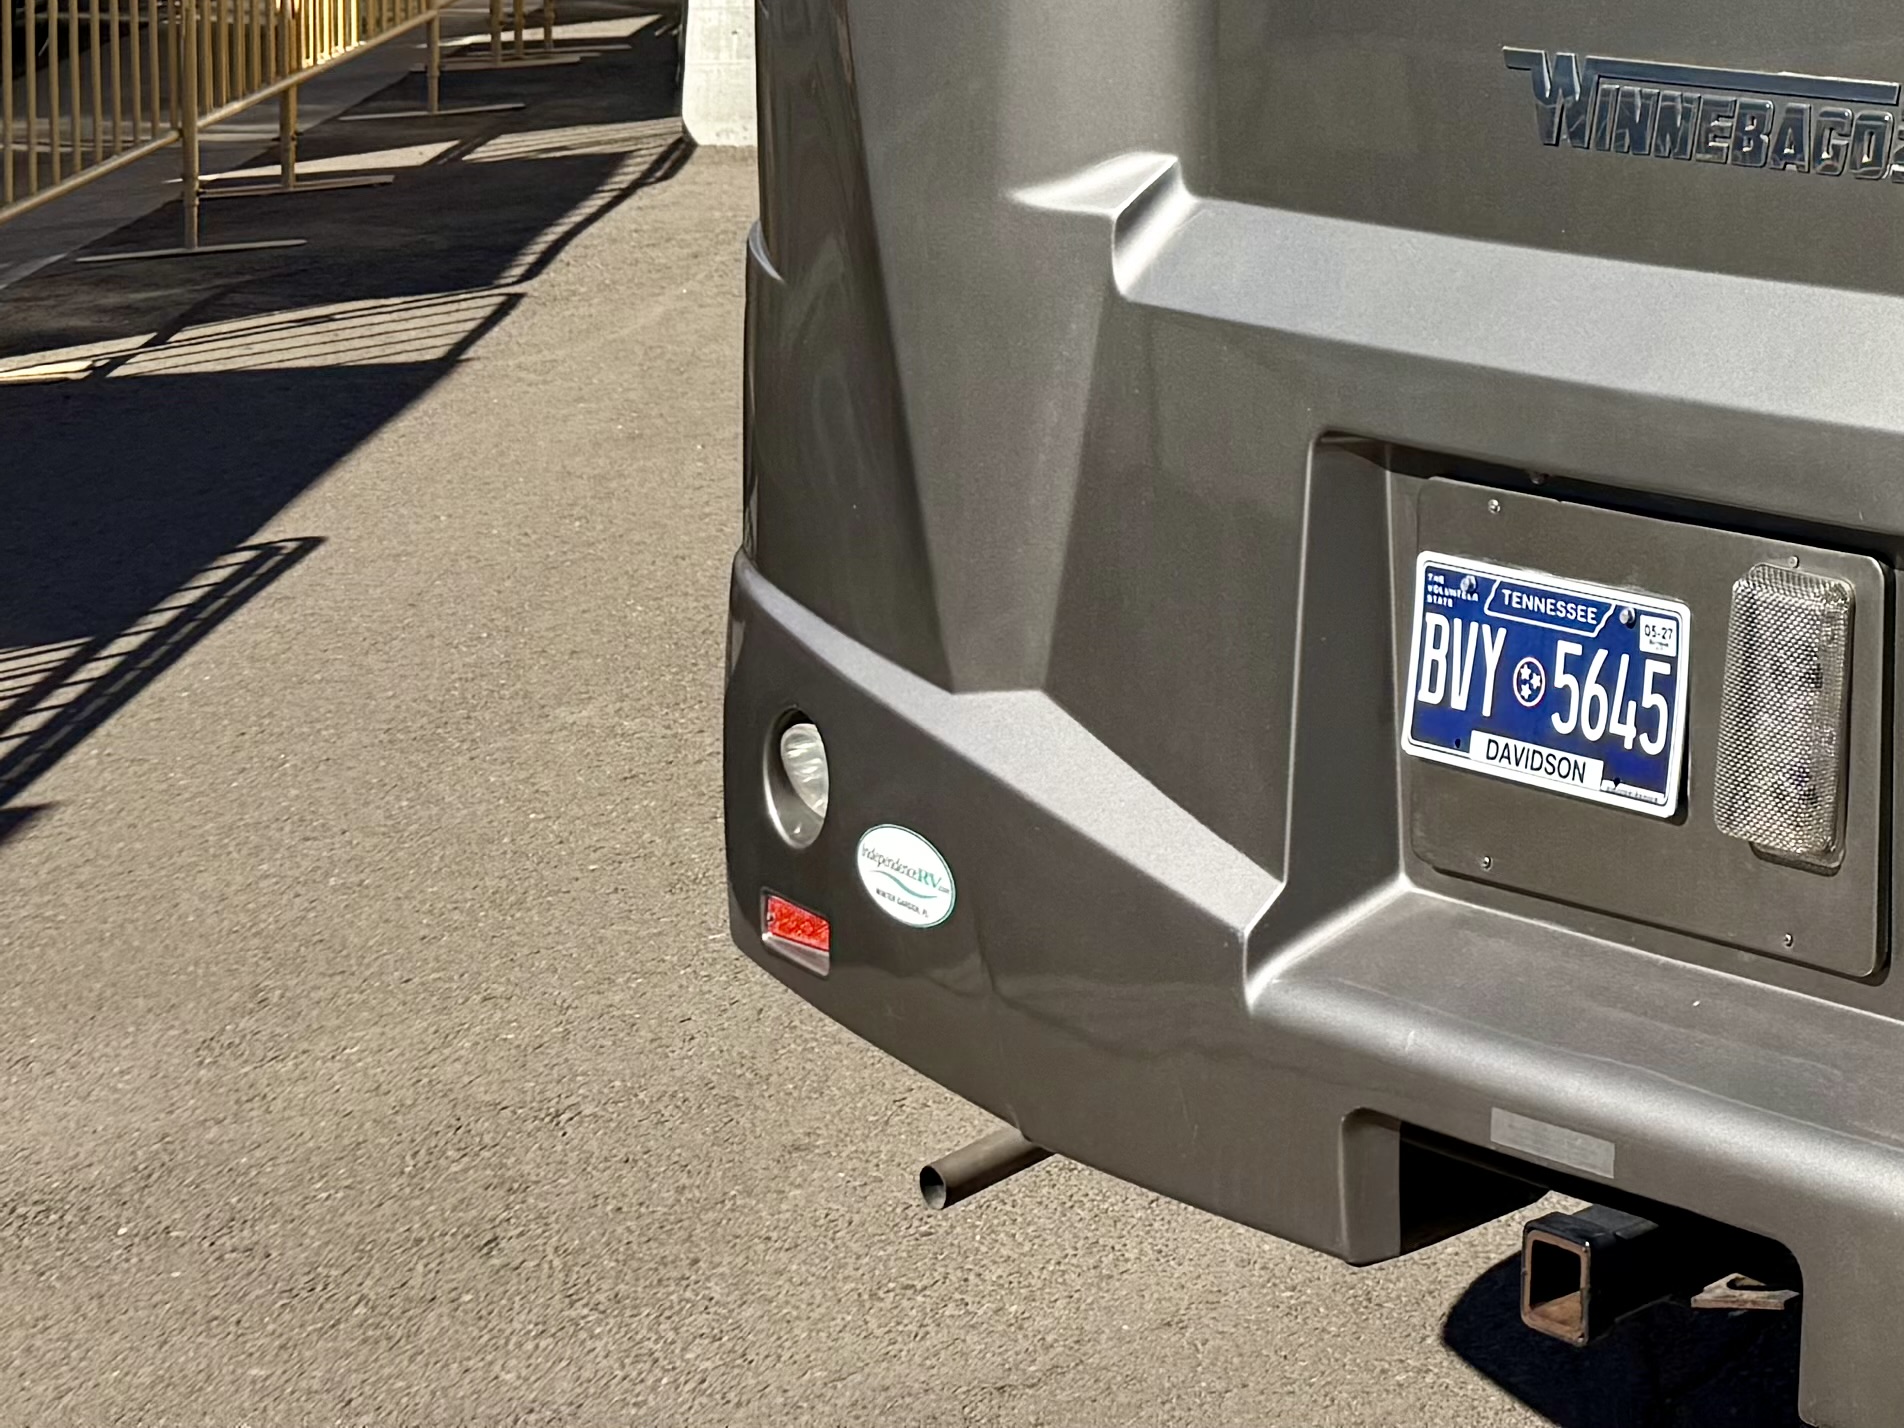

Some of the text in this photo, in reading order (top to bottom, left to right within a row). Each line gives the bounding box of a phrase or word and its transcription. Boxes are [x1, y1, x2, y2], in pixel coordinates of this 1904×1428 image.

[1502, 45, 1901, 181] WINNEBAGO
[1501, 588, 1598, 626] TENNESSEE
[1644, 624, 1674, 640] 05-27
[1417, 612, 1672, 756] BVY 5645
[1486, 738, 1587, 784] DAVIDSON
